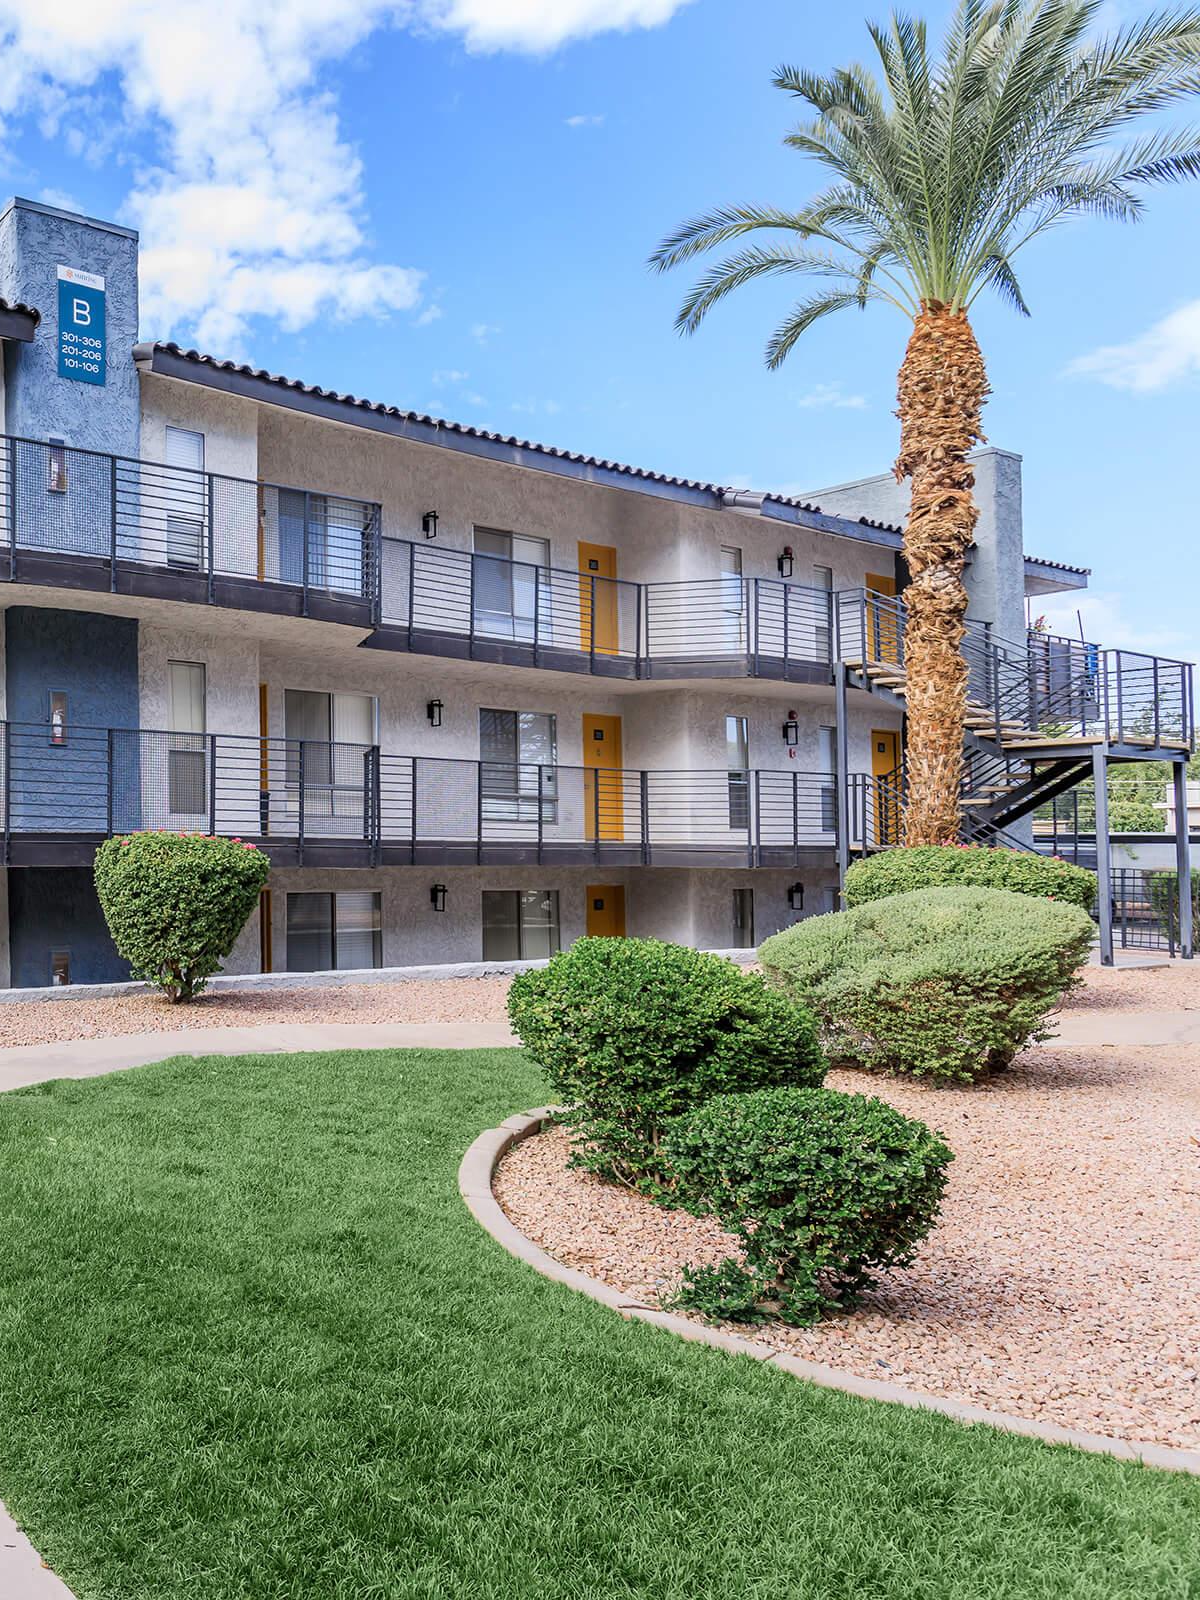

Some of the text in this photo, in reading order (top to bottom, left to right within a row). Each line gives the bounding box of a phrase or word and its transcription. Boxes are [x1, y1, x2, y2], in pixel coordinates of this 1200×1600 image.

[73, 298, 91, 326] B
[62, 331, 102, 349] 301-306
[62, 344, 102, 361] 201-206
[64, 358, 100, 373] 101-106
